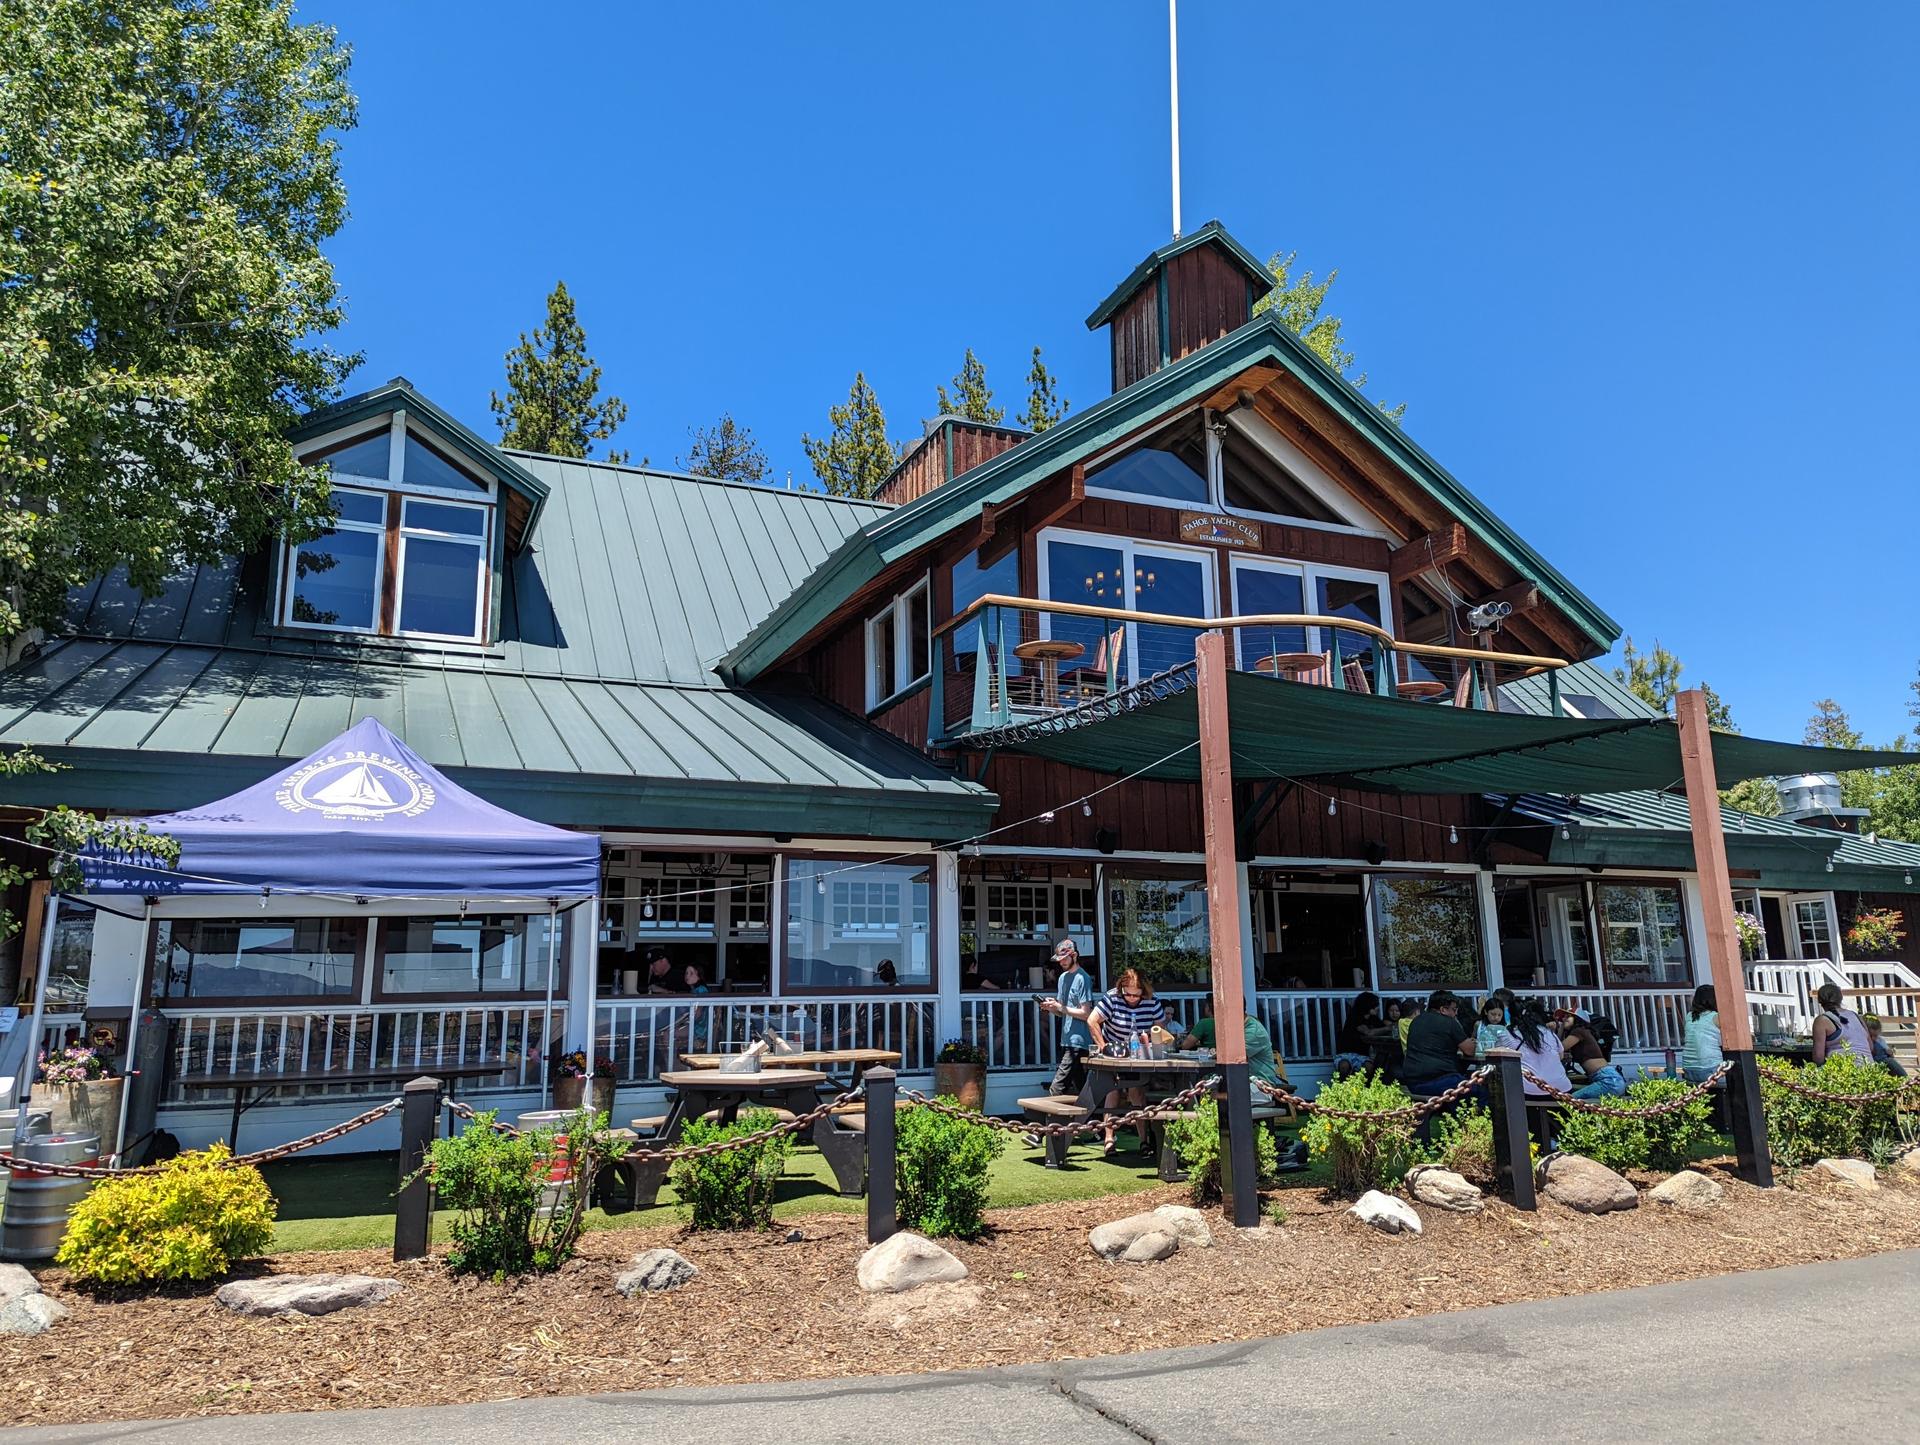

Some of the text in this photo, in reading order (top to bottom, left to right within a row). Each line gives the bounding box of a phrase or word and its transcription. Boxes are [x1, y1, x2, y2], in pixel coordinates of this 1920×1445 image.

[1183, 517, 1259, 541] TAHOE YACHT CLUB
[275, 751, 435, 817] THREE SHEETS BREWING COMPANY
